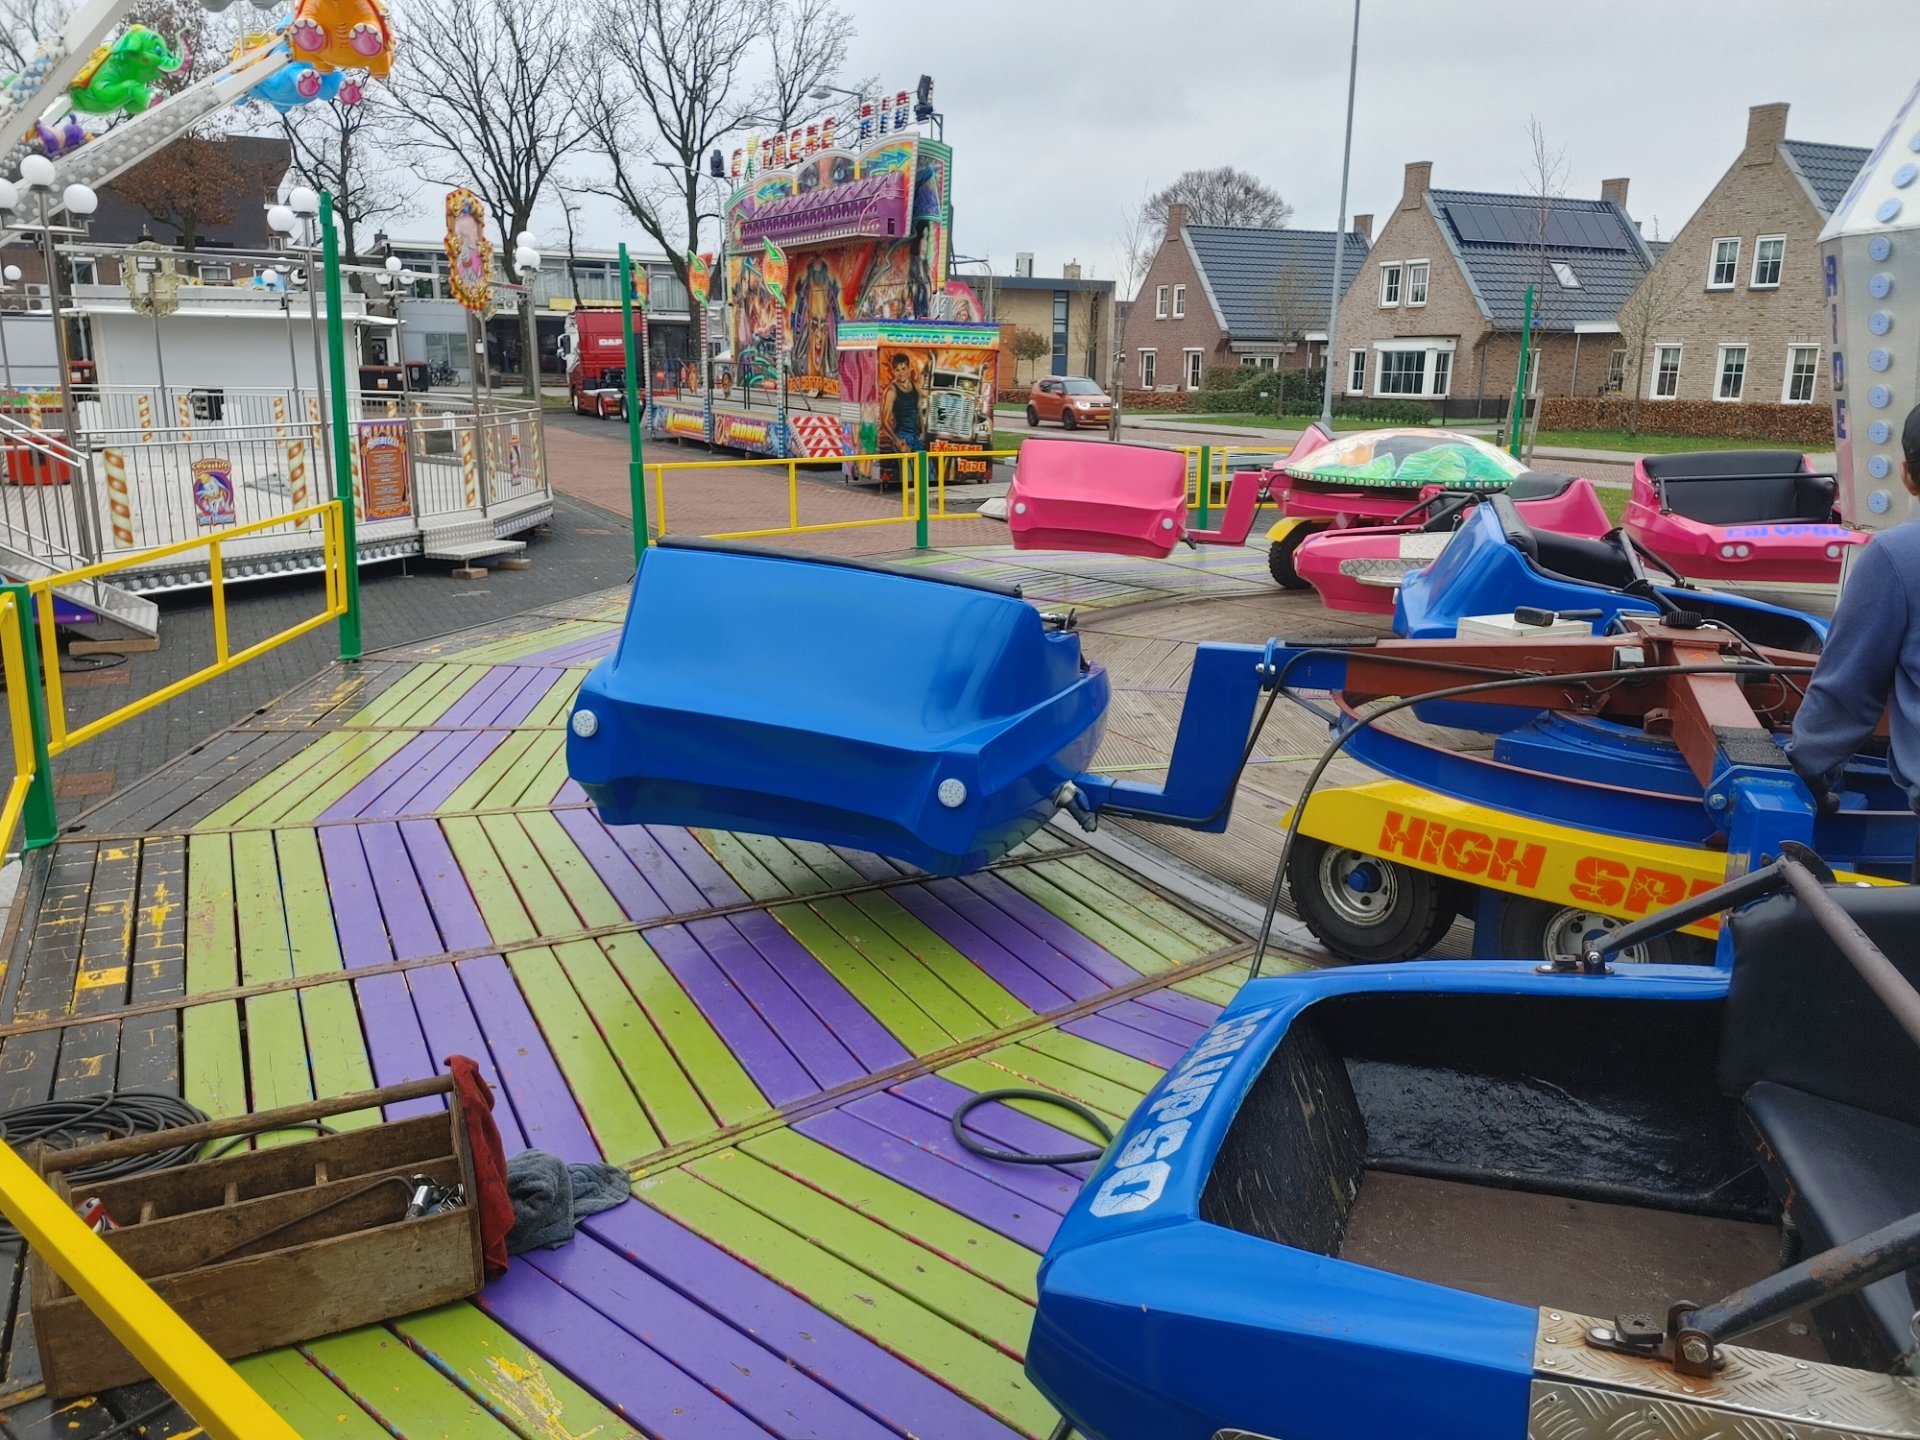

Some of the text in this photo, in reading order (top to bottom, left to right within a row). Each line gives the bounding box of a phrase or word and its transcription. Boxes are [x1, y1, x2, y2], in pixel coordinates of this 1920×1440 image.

[598, 338, 623, 346] DAF
[886, 333, 947, 344] CONTROL
[951, 335, 992, 346] ROOM
[929, 439, 983, 454] EXTREME
[957, 458, 987, 473] RIDE
[1378, 810, 1546, 889] HIGH
[1089, 1008, 1272, 1218] CALYPSO
